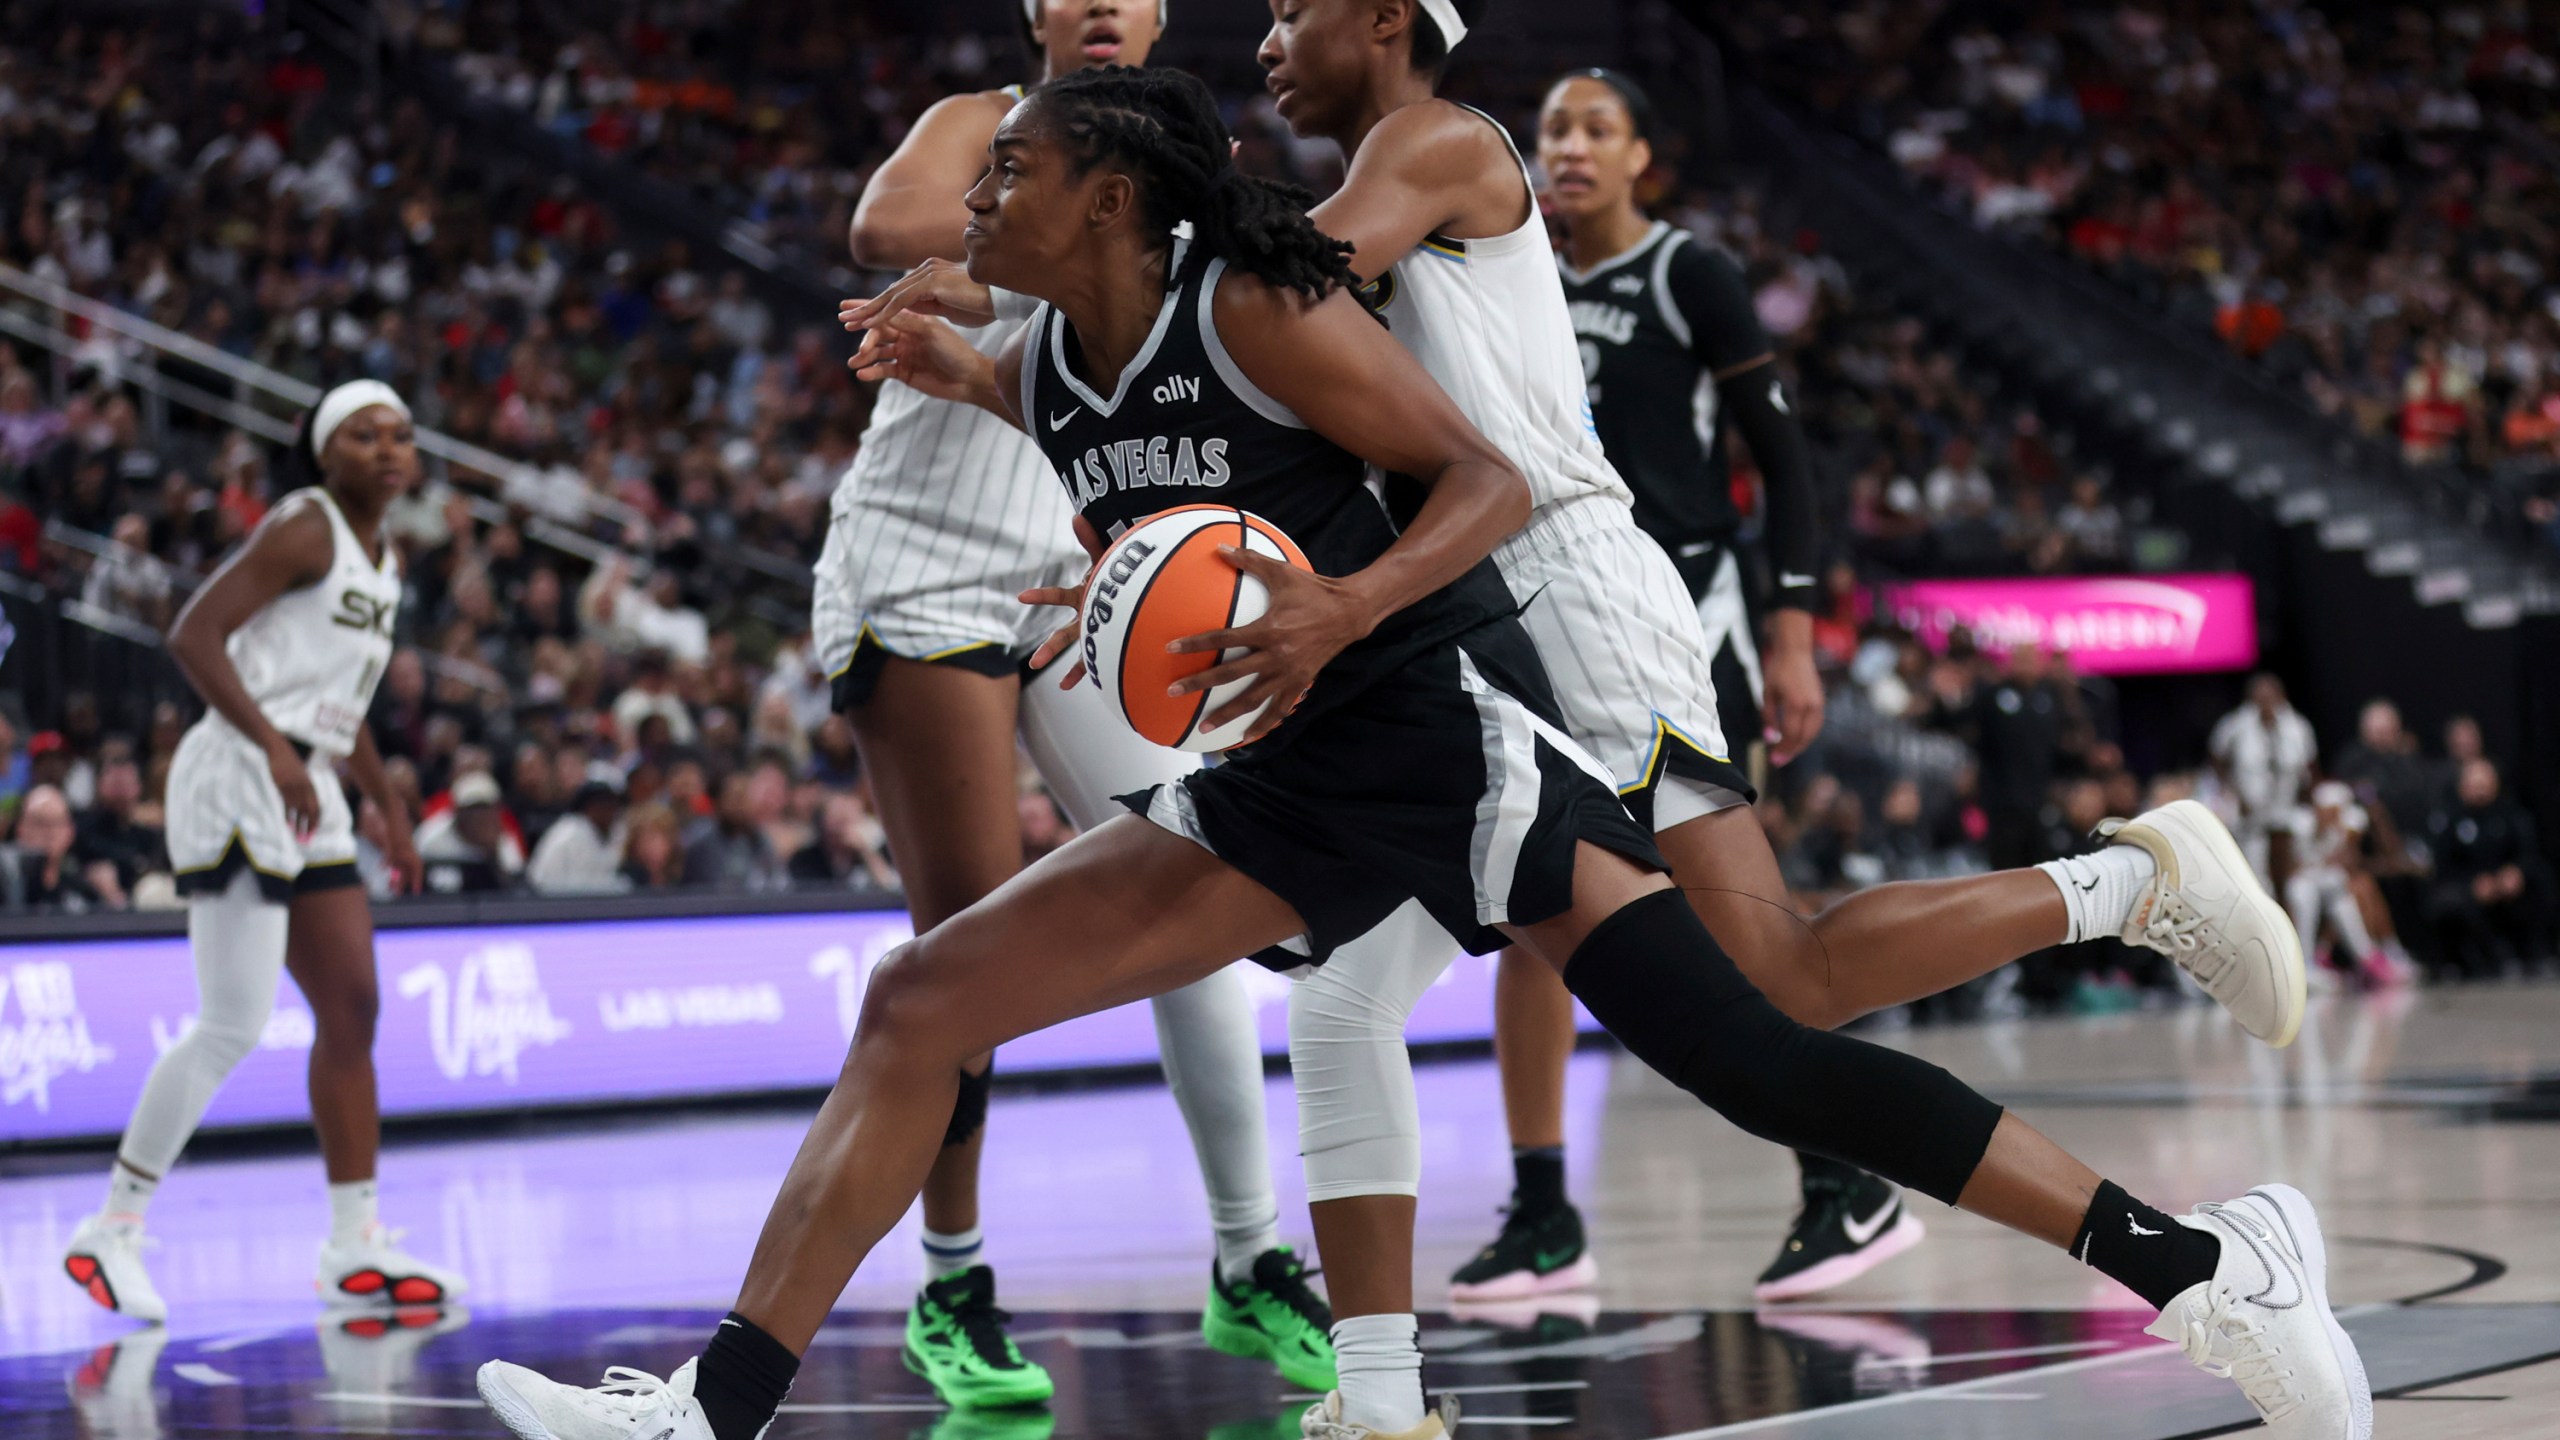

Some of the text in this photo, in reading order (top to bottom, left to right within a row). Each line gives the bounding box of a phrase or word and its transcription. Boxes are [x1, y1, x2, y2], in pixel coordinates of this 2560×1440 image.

[1153, 374, 1200, 404] ally
[1061, 435, 1231, 516] LAS VEGAS
[1085, 539, 1157, 691] Wilson
